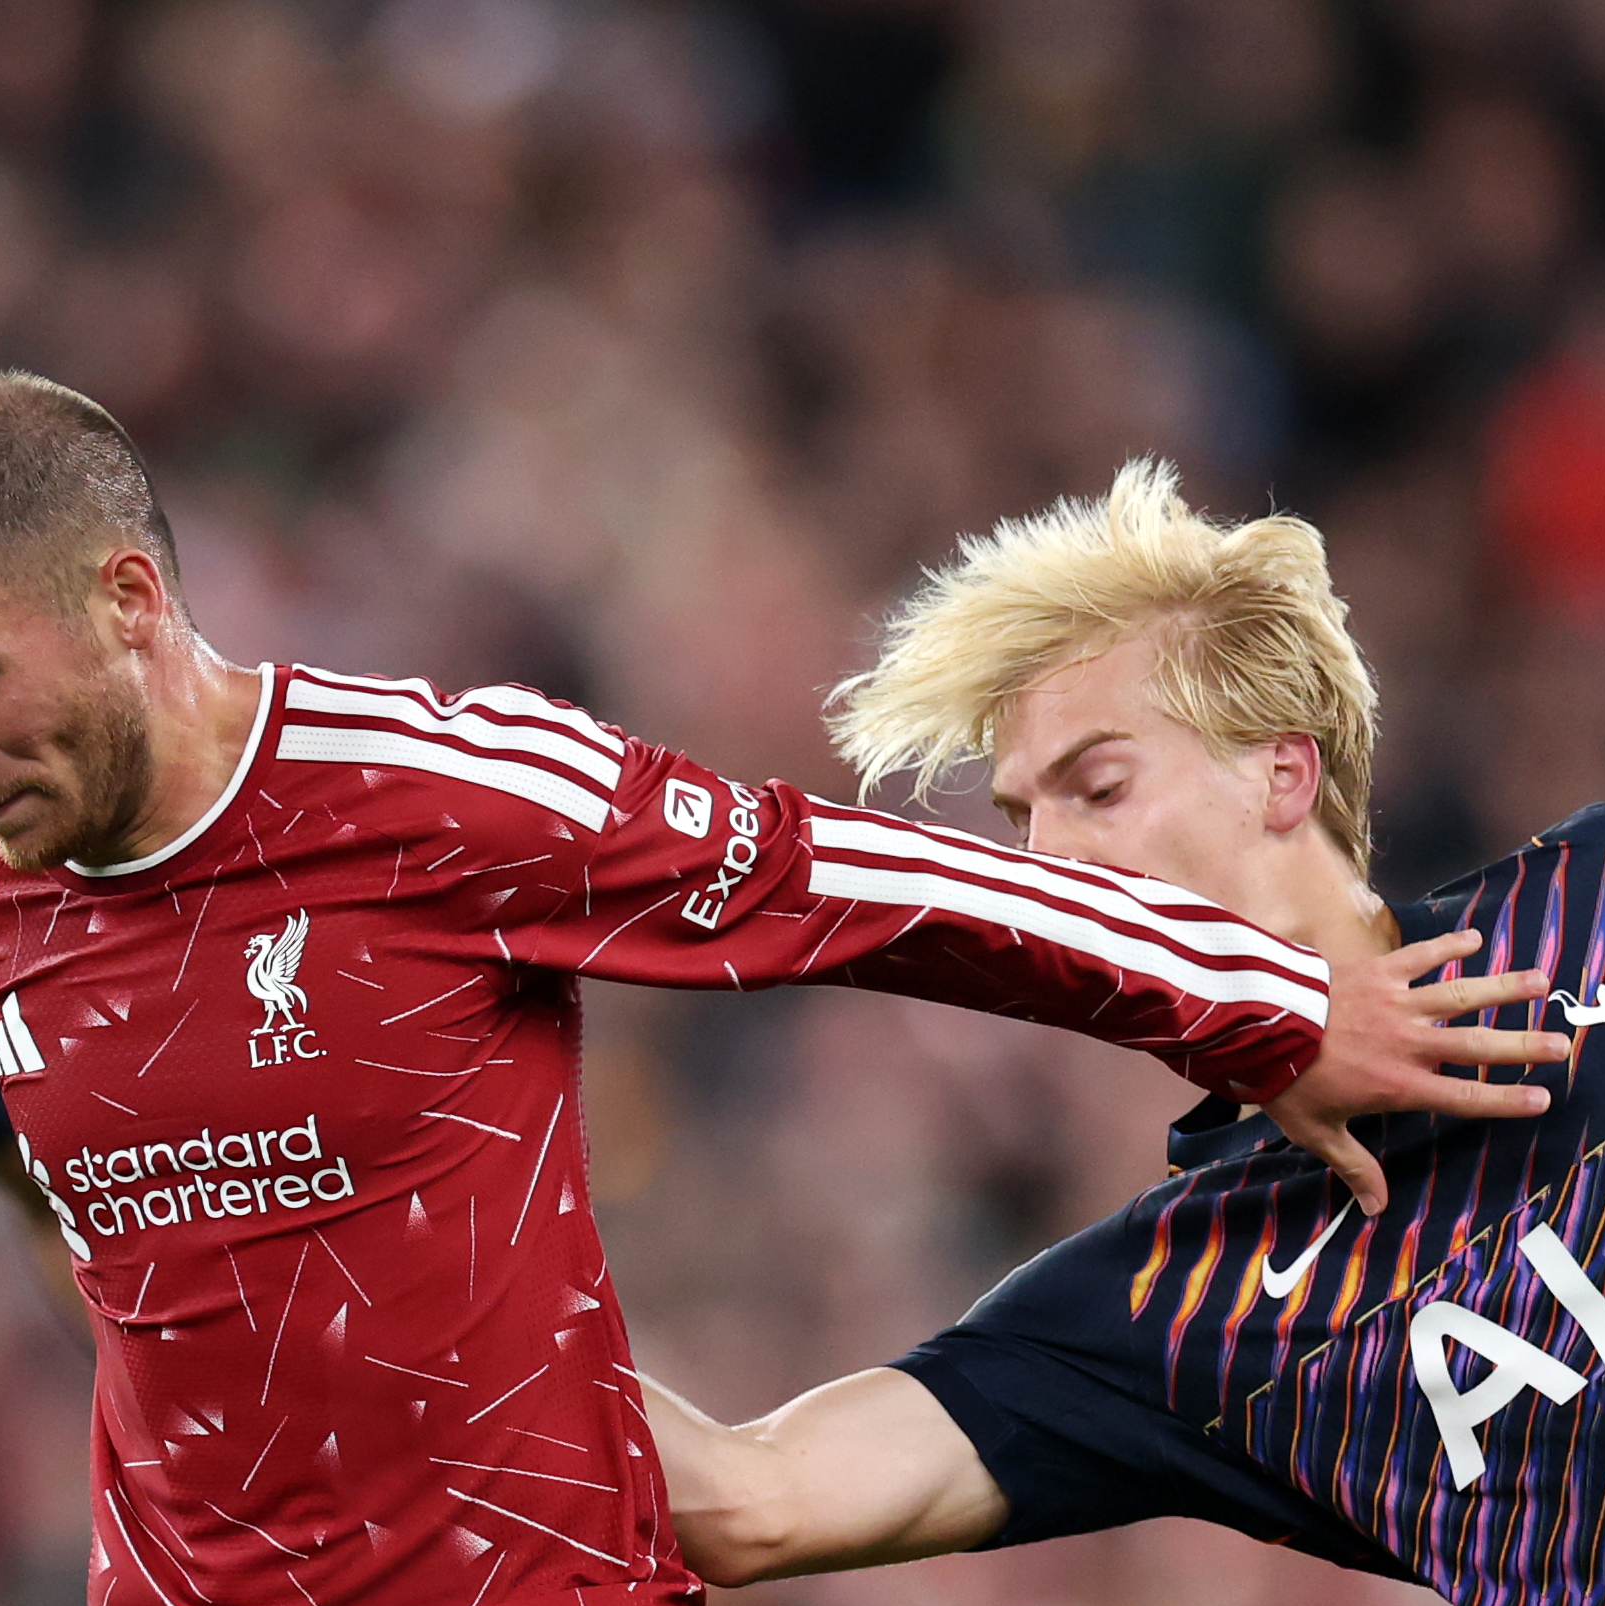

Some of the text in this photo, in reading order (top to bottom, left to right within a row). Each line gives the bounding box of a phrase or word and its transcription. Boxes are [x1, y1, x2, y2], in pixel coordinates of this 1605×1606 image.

[248, 1030, 328, 1068] L.F.C.
[65, 1113, 322, 1193] standard
[87, 1156, 355, 1236] chartered
